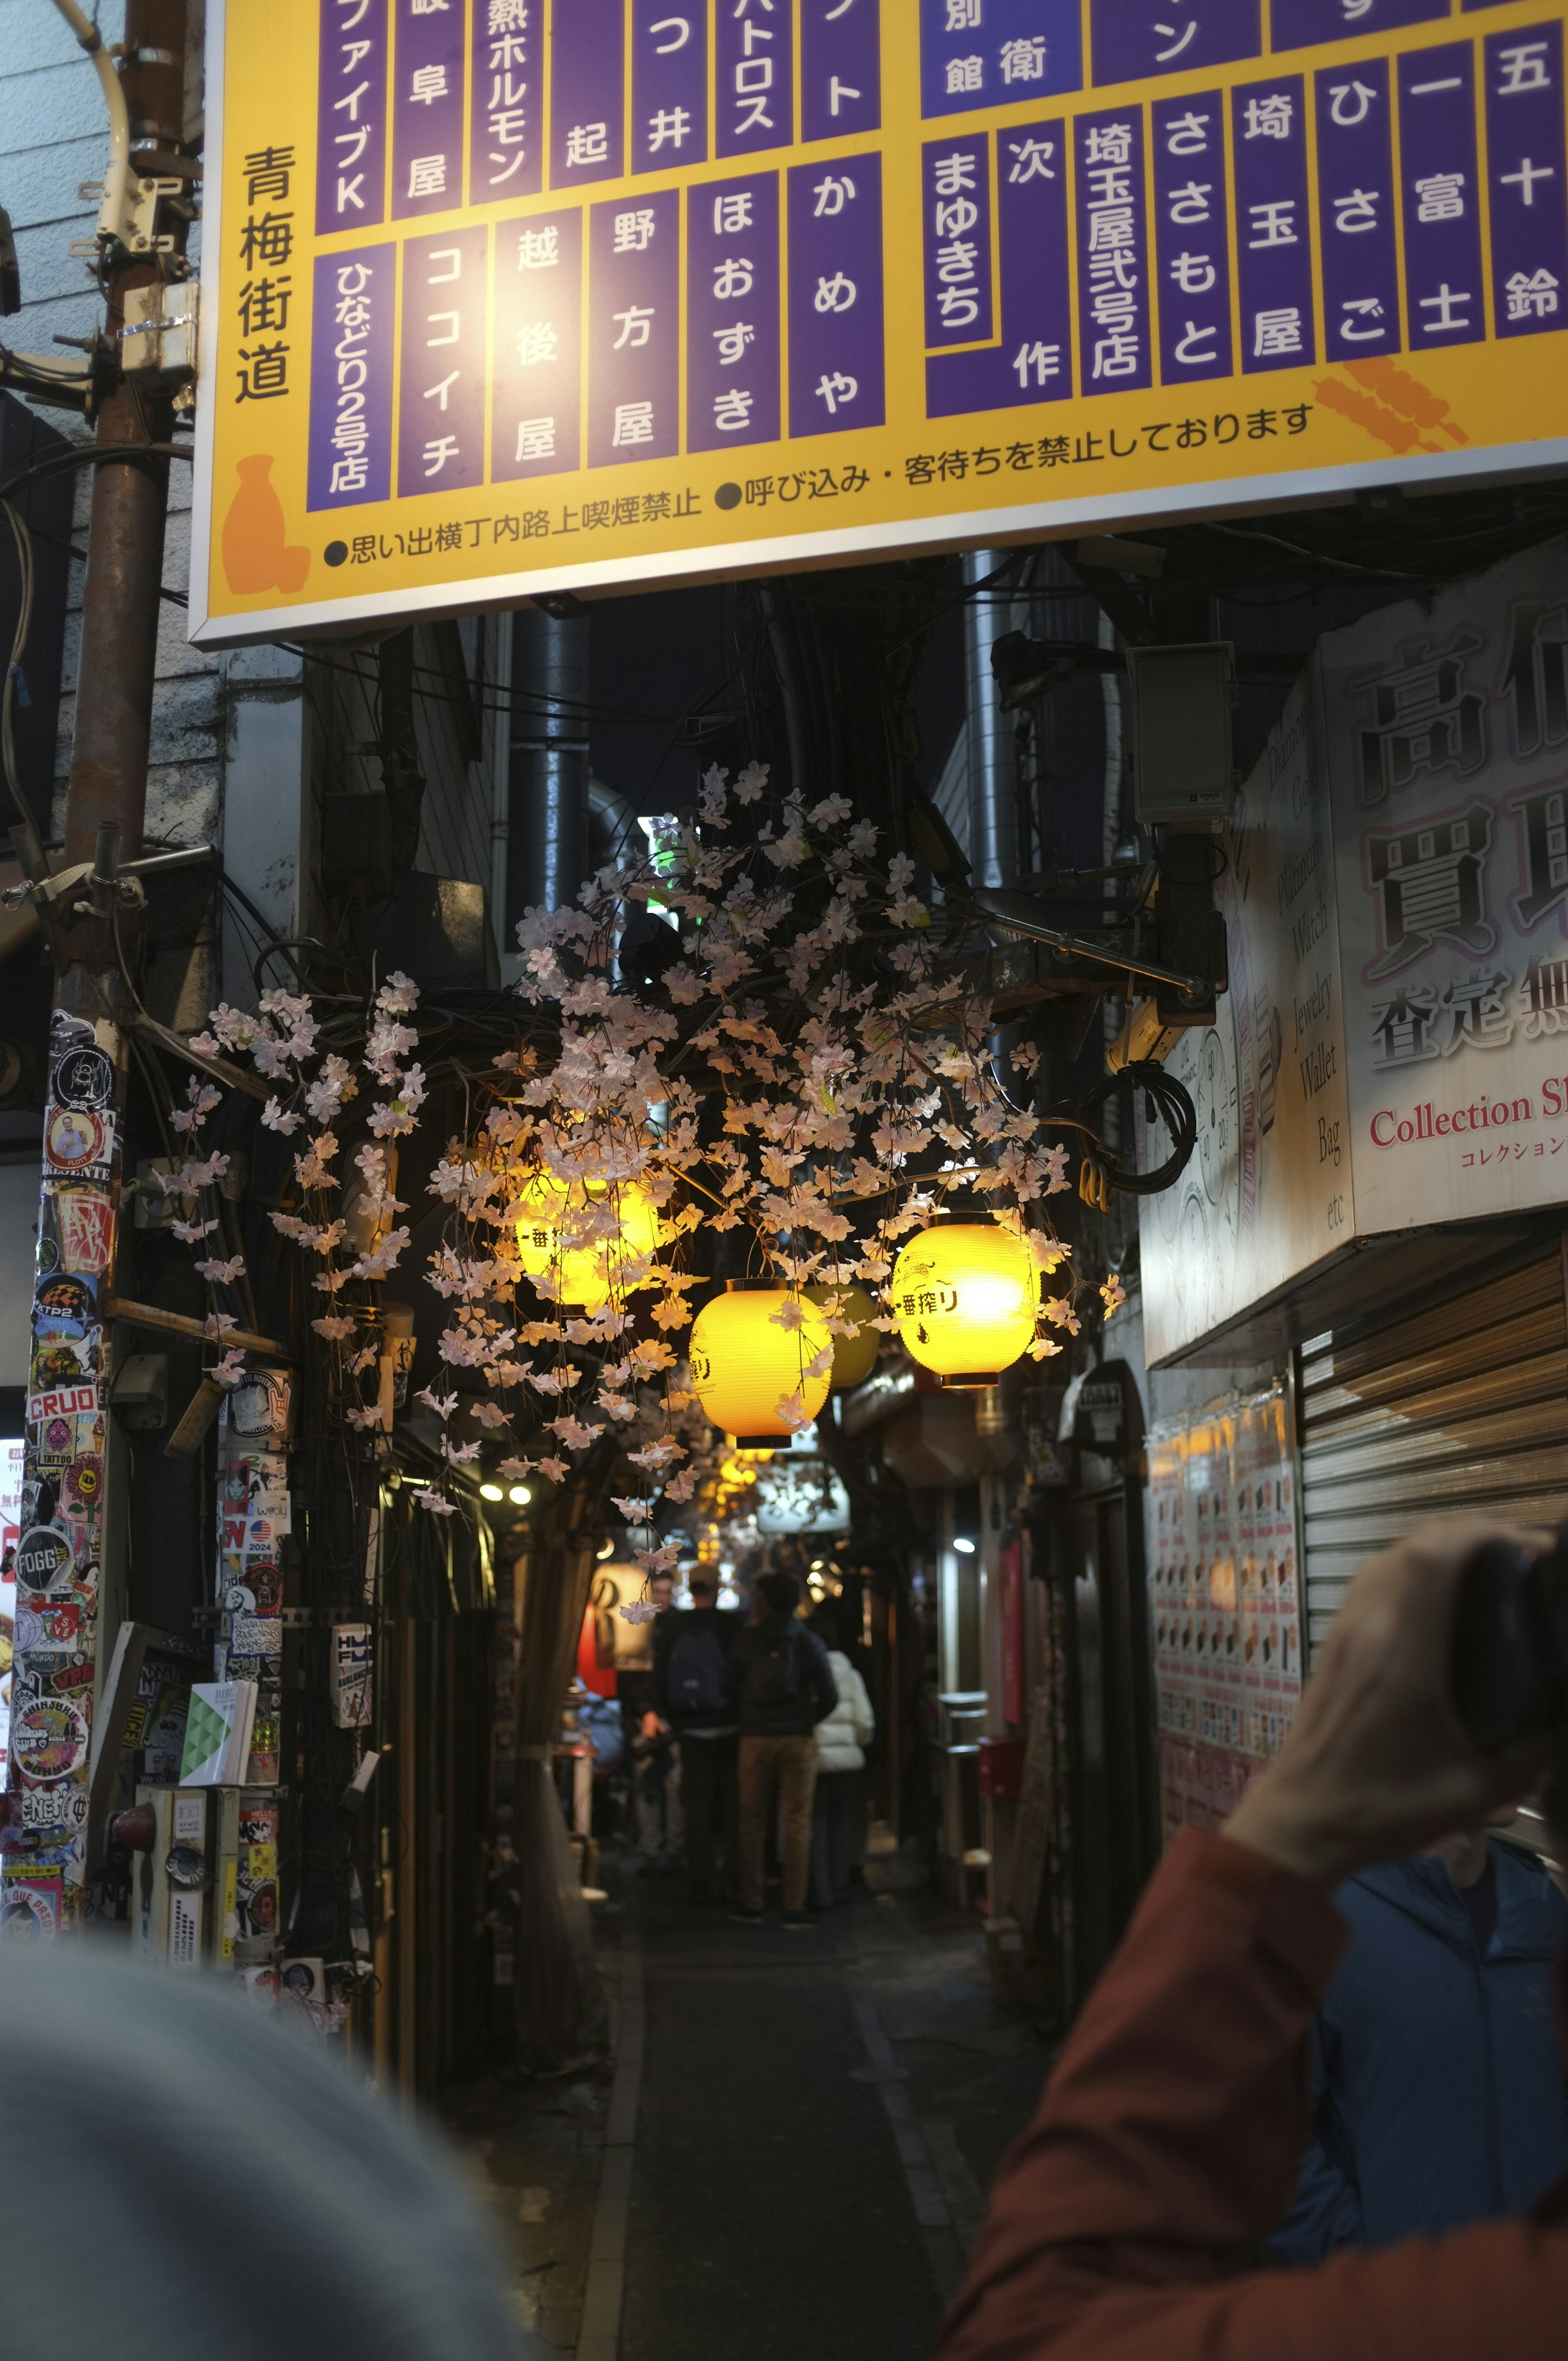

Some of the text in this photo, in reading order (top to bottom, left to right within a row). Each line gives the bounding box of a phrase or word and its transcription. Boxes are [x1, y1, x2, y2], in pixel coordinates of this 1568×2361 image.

[488, 0, 528, 184] 熱ホルモン
[934, 153, 980, 328] まゆきち
[1085, 123, 1139, 379] 埼玉屋弐号店
[1165, 111, 1217, 364] ささもと
[1243, 93, 1303, 357] 埼玉屋
[1329, 80, 1386, 341] ひさご
[1409, 77, 1472, 333] 一富士
[1496, 41, 1559, 320] 五十鈴
[235, 145, 296, 404] 青梅街道
[515, 225, 558, 463] 越後屋
[612, 209, 655, 447] 野方屋
[712, 192, 755, 431] ほおずき
[813, 176, 858, 414] かめや
[329, 263, 373, 493] ひなどり2号店
[423, 247, 460, 477] ココイチ
[350, 402, 1314, 565] 思い出横丁内路上喫煙禁止 呼び込み・客待ちを禁止しております
[1292, 893, 1328, 965] Watch
[1293, 970, 1332, 1053] Jewelry
[1300, 1041, 1336, 1102] Wallet
[1317, 1116, 1340, 1166] Bag
[1369, 1095, 1533, 1148] Collection
[1461, 1136, 1568, 1168] コレクション
[68, 1156, 88, 1167] FLOTT
[1327, 1194, 1344, 1231] etc
[34, 1298, 73, 1318] #KTP2
[31, 1388, 94, 1421] CRUO
[43, 1454, 72, 1465] TATTOO
[18, 1549, 57, 1574] FOGG
[23, 1700, 79, 1720] SHINJUKU
[29, 1652, 55, 1662] MUNDO
